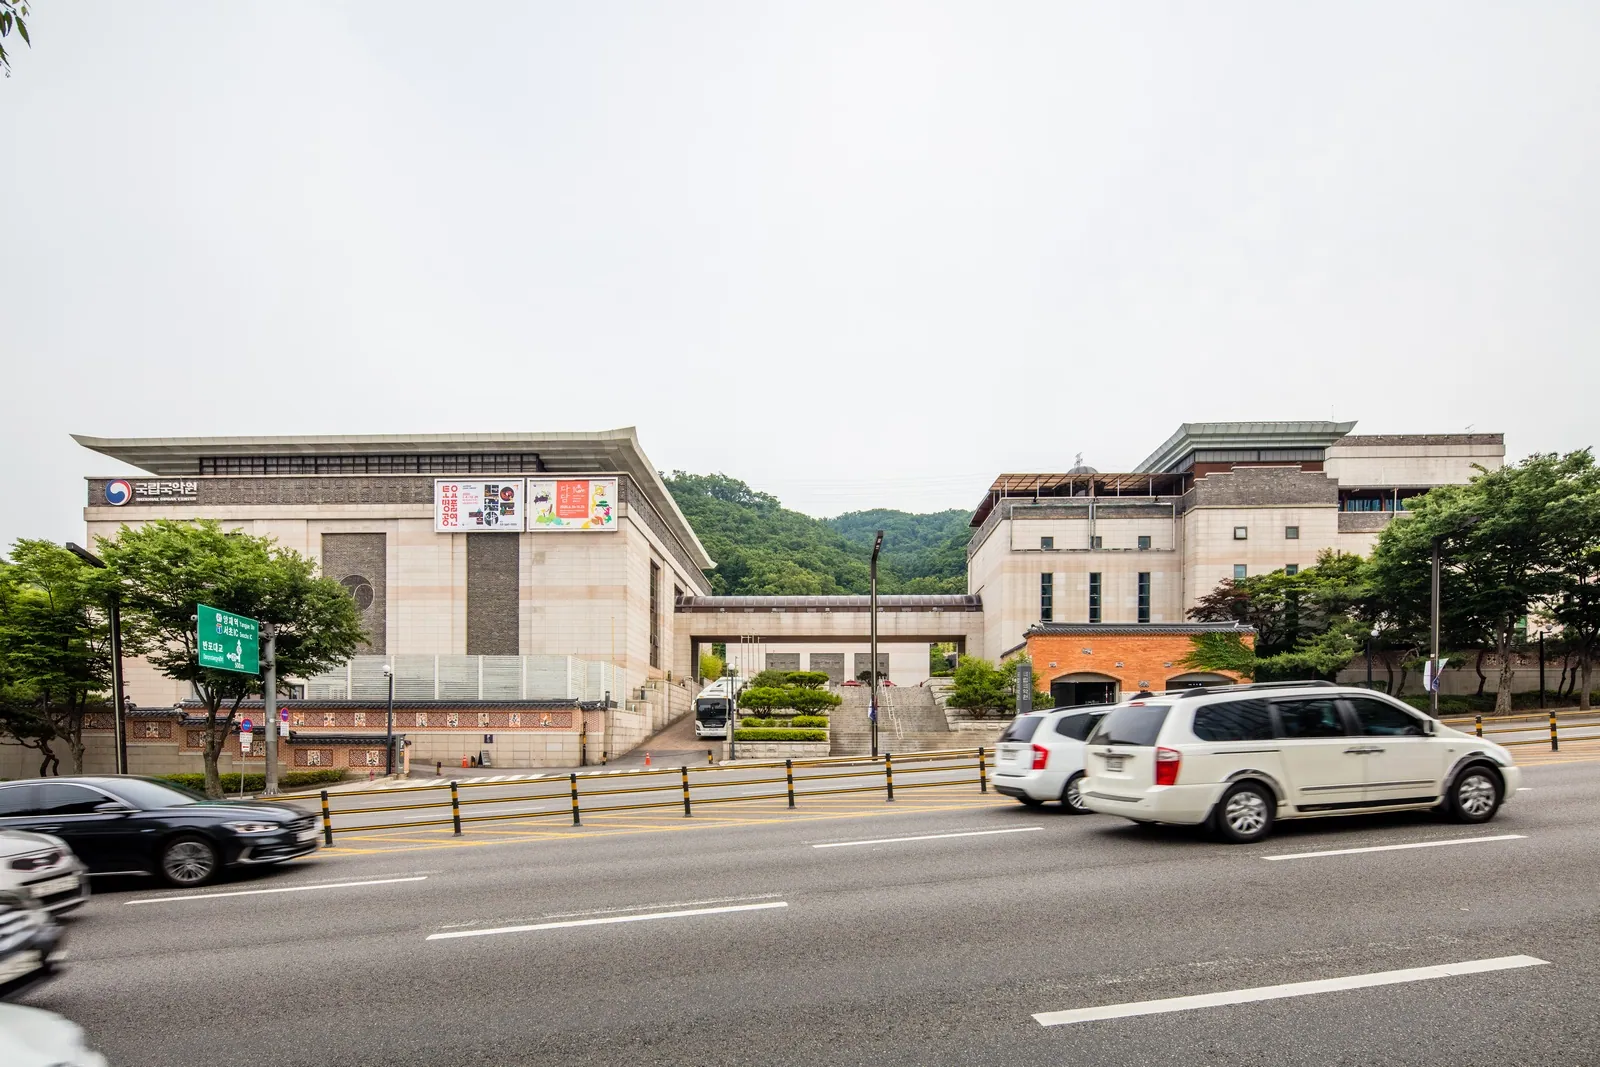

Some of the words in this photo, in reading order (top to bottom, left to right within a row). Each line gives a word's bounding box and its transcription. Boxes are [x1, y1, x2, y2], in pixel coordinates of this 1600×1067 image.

[135, 482, 198, 495] 국립국악원
[223, 615, 239, 628] 양재역
[202, 641, 223, 653] 반포대교
